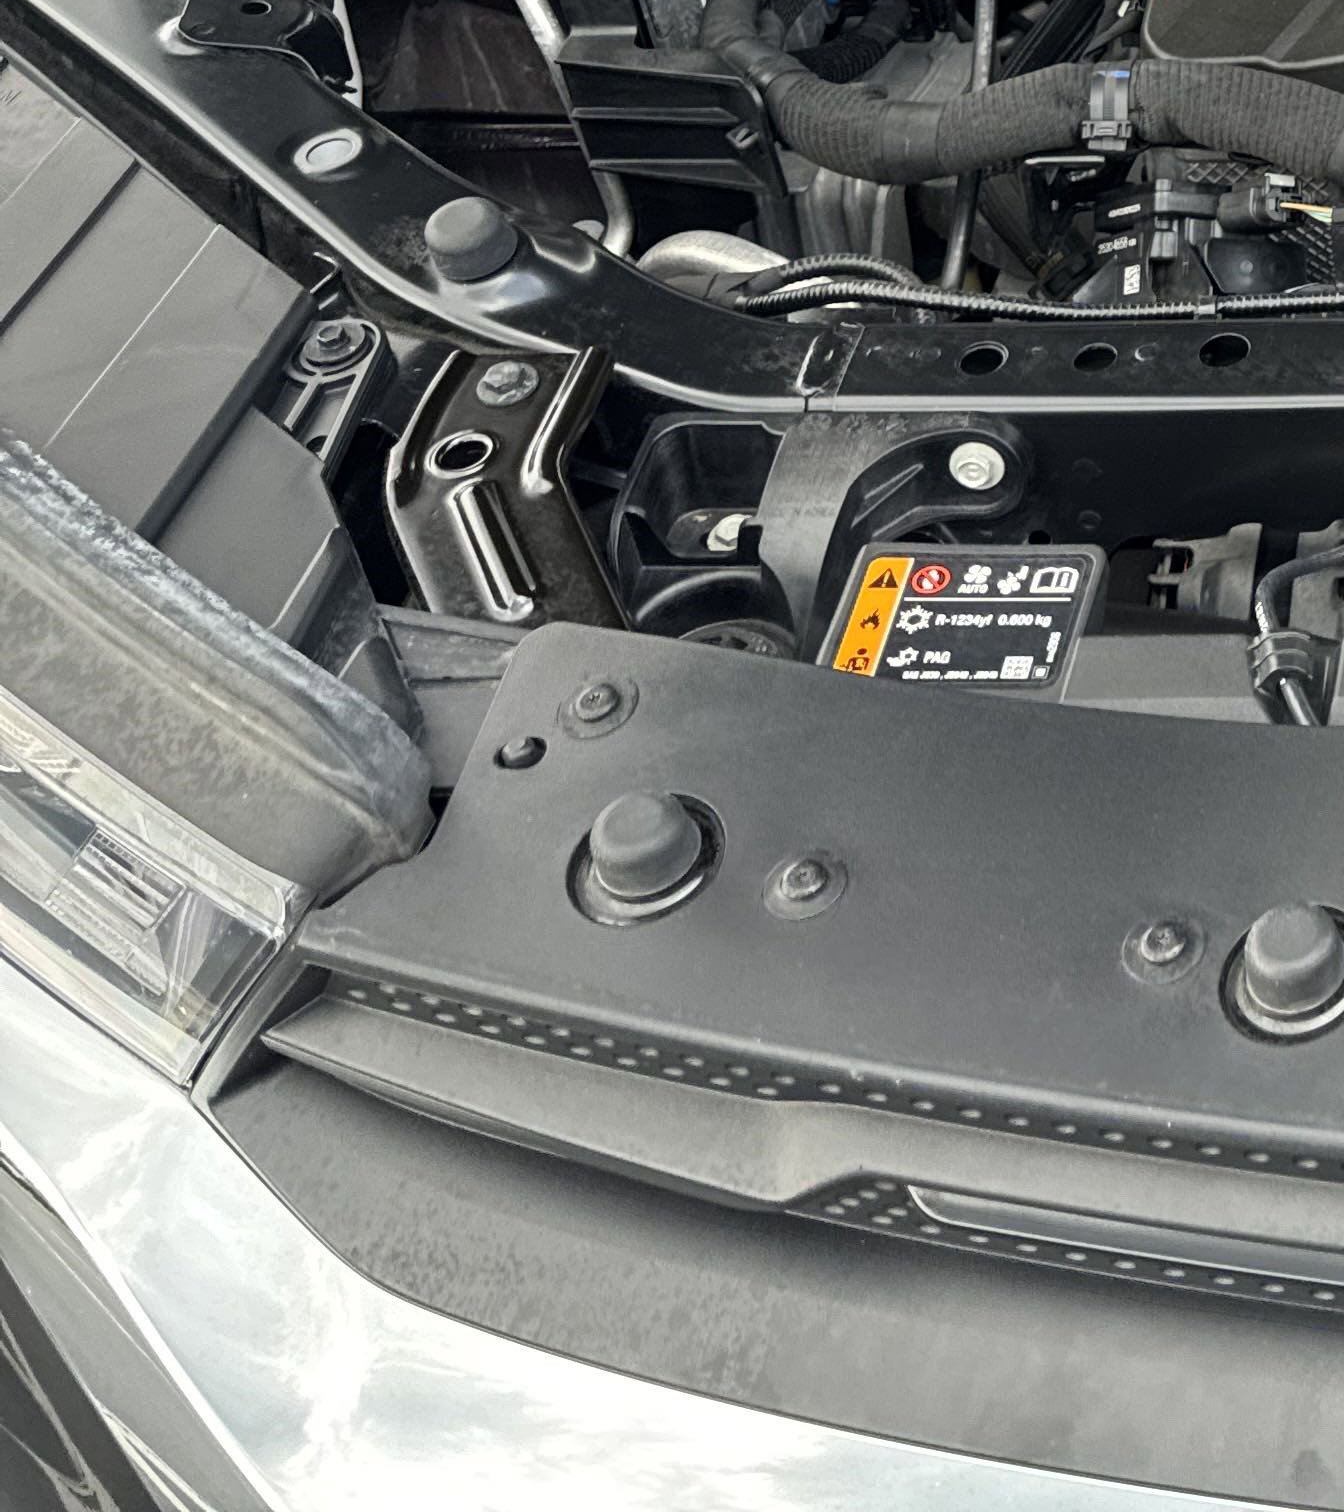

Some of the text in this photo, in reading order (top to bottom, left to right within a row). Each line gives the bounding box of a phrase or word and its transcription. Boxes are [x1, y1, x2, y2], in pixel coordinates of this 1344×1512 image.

[957, 582, 989, 595] AUTO
[934, 613, 992, 629] R-1234yf
[1034, 613, 1052, 629] kg
[922, 650, 952, 665] PAG
